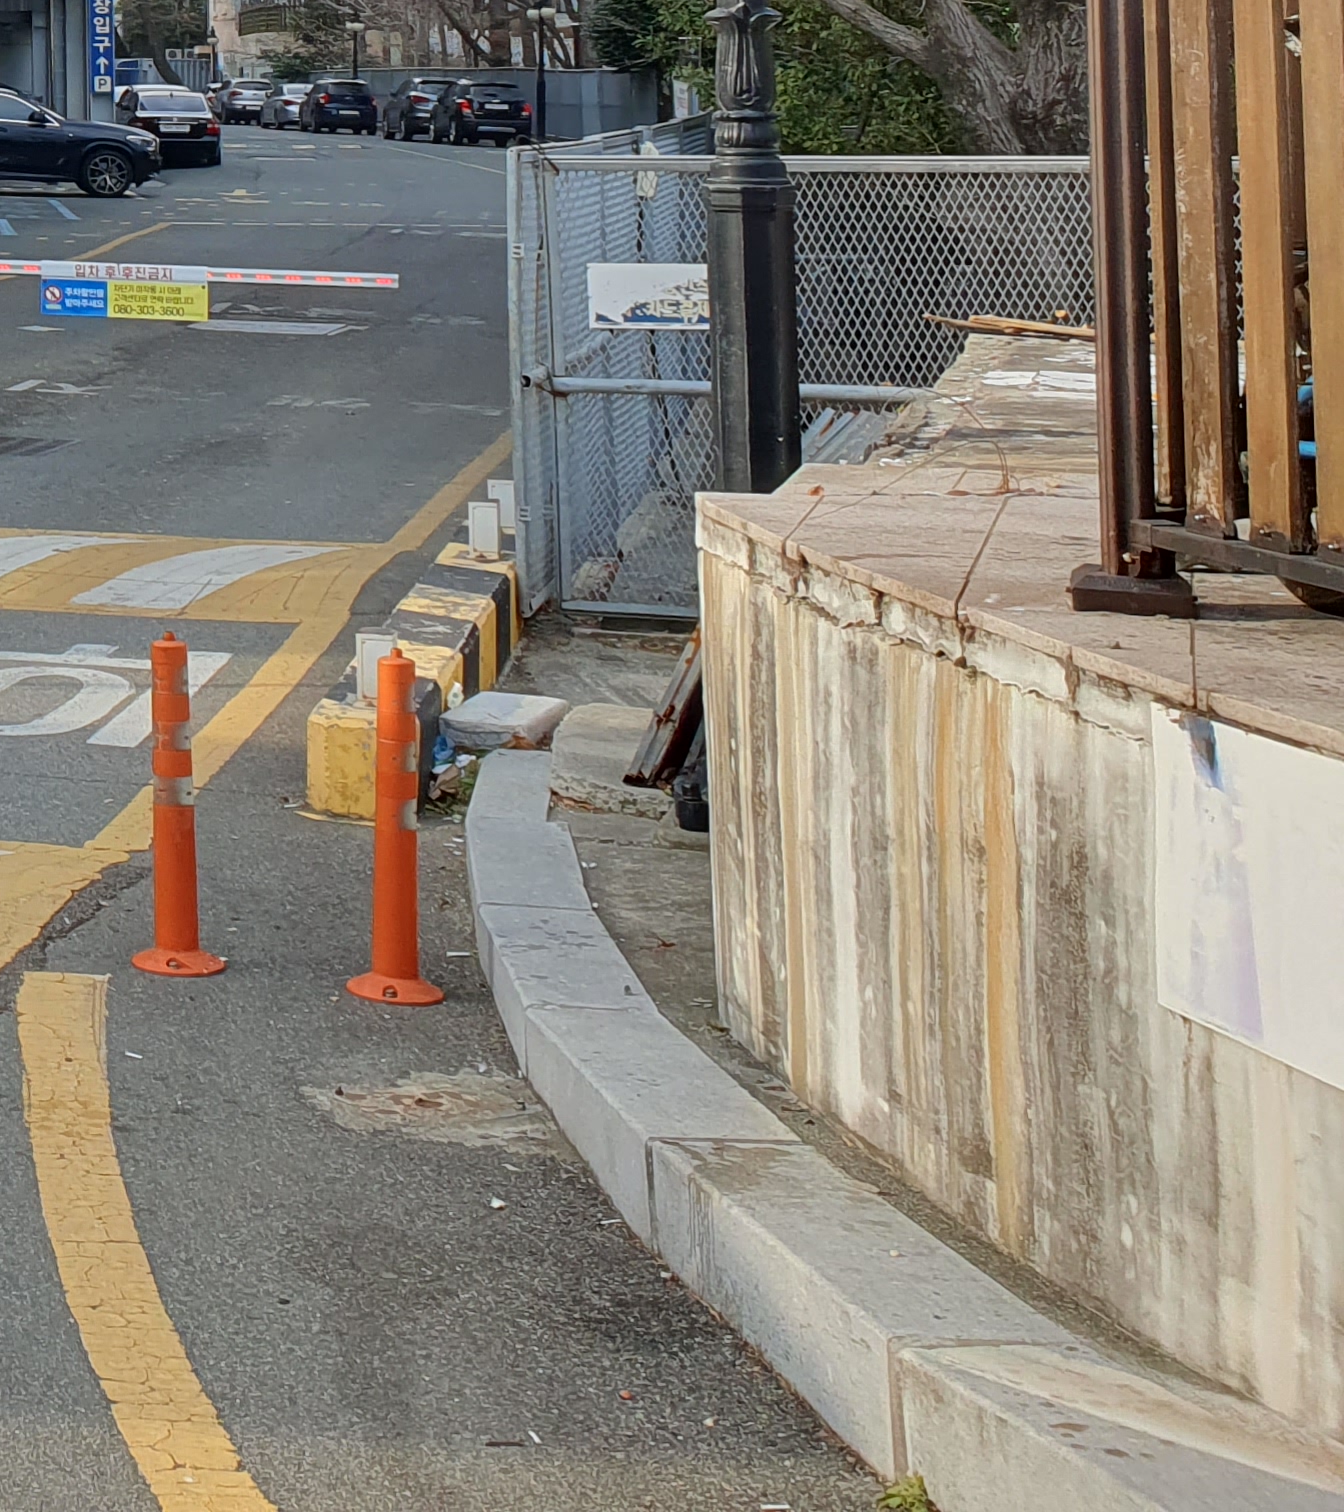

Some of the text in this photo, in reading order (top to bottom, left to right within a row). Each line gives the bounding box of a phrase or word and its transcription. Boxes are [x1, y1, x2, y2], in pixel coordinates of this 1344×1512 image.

[74, 263, 173, 281] 입차 후 후진금지
[113, 284, 135, 295] 차단기
[159, 286, 166, 295] 시
[113, 304, 185, 317] 080-303-3600
